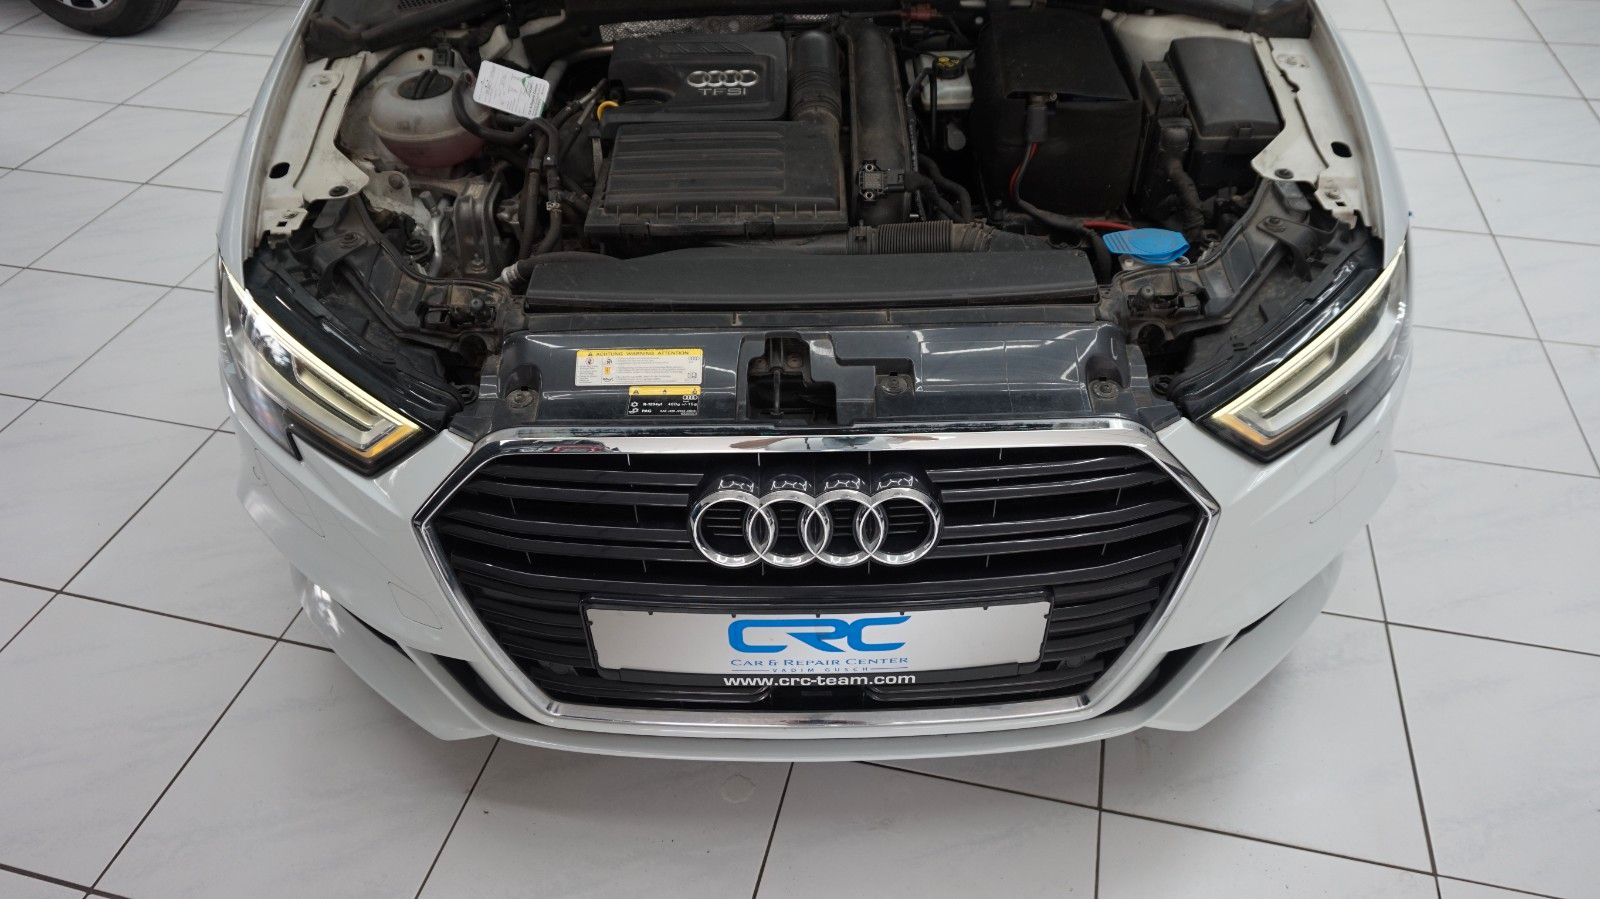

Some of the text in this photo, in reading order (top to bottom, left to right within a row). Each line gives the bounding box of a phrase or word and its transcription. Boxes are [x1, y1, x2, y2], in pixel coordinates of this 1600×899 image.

[698, 87, 746, 96] TFSI
[728, 616, 911, 653] CRC
[845, 657, 908, 666] CENTER
[723, 675, 916, 687] www.crc-team.com
